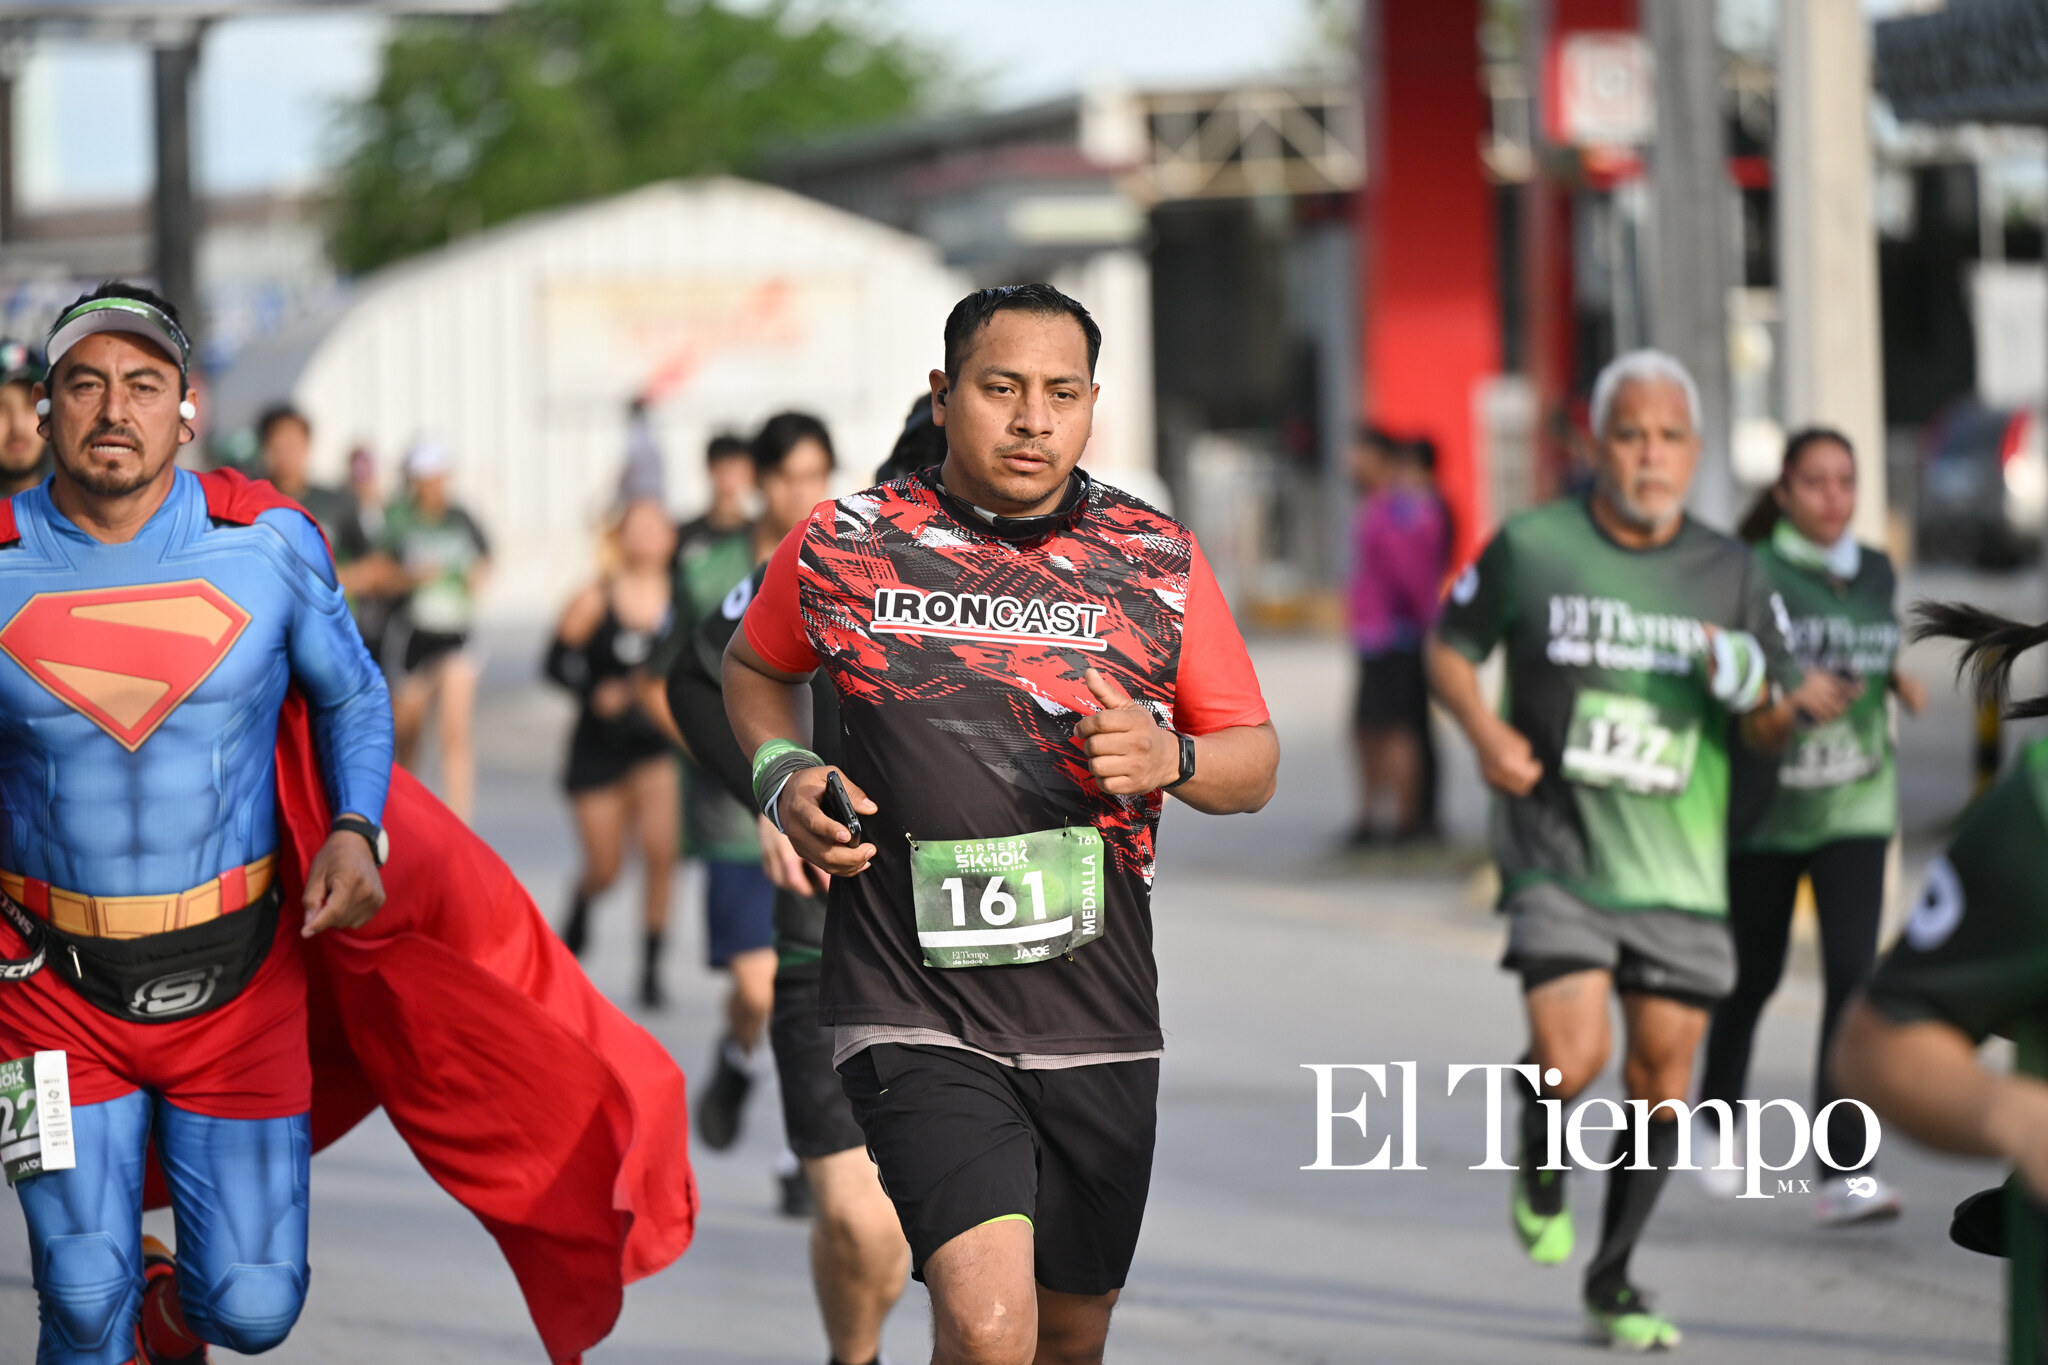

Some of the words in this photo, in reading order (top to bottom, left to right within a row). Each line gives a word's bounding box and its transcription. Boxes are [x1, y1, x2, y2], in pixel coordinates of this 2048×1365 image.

[875, 588, 1107, 638] IRONCAST
[1588, 716, 1671, 764] 127
[953, 839, 1028, 854] CARRERA
[1077, 835, 1098, 846] 161
[941, 870, 1047, 927] 161
[1081, 853, 1096, 935] MEDALLA
